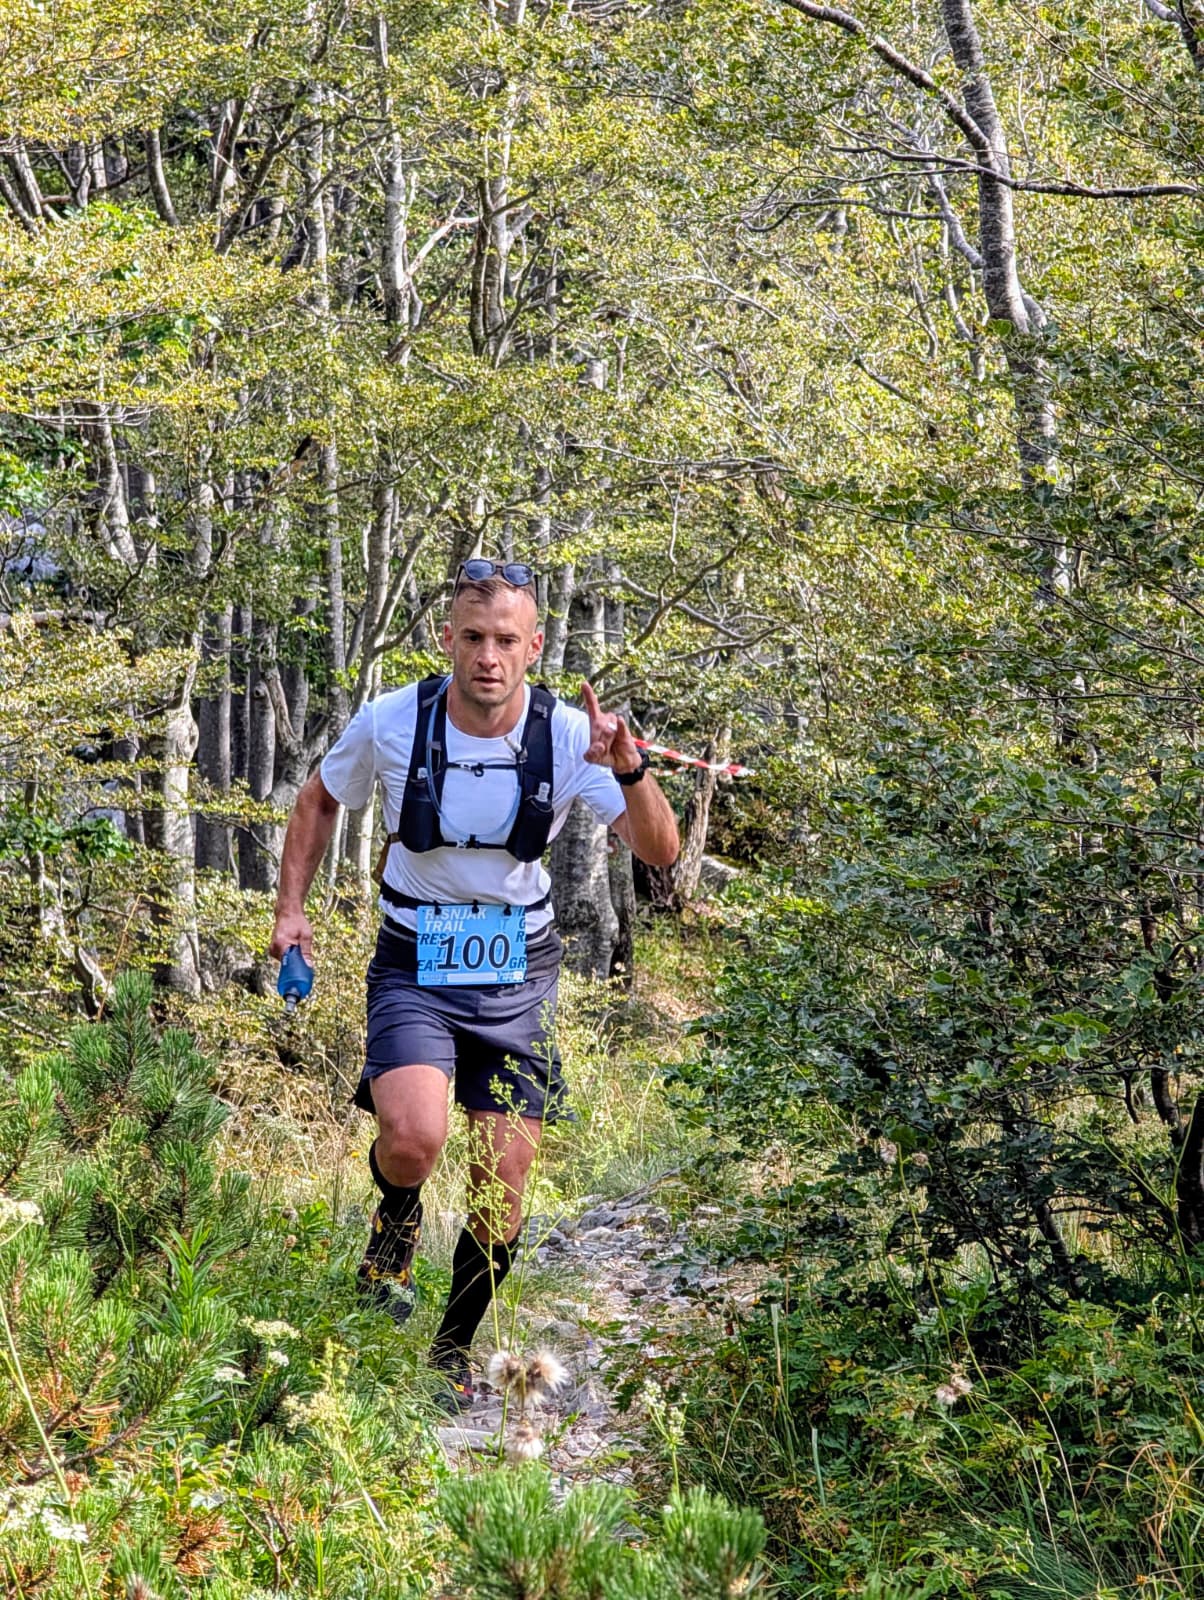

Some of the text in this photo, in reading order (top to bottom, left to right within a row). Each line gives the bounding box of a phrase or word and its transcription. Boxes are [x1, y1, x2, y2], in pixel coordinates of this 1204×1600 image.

[425, 907, 487, 920] RSNJAK
[424, 920, 466, 932] TRAIL
[436, 933, 511, 970] 100
